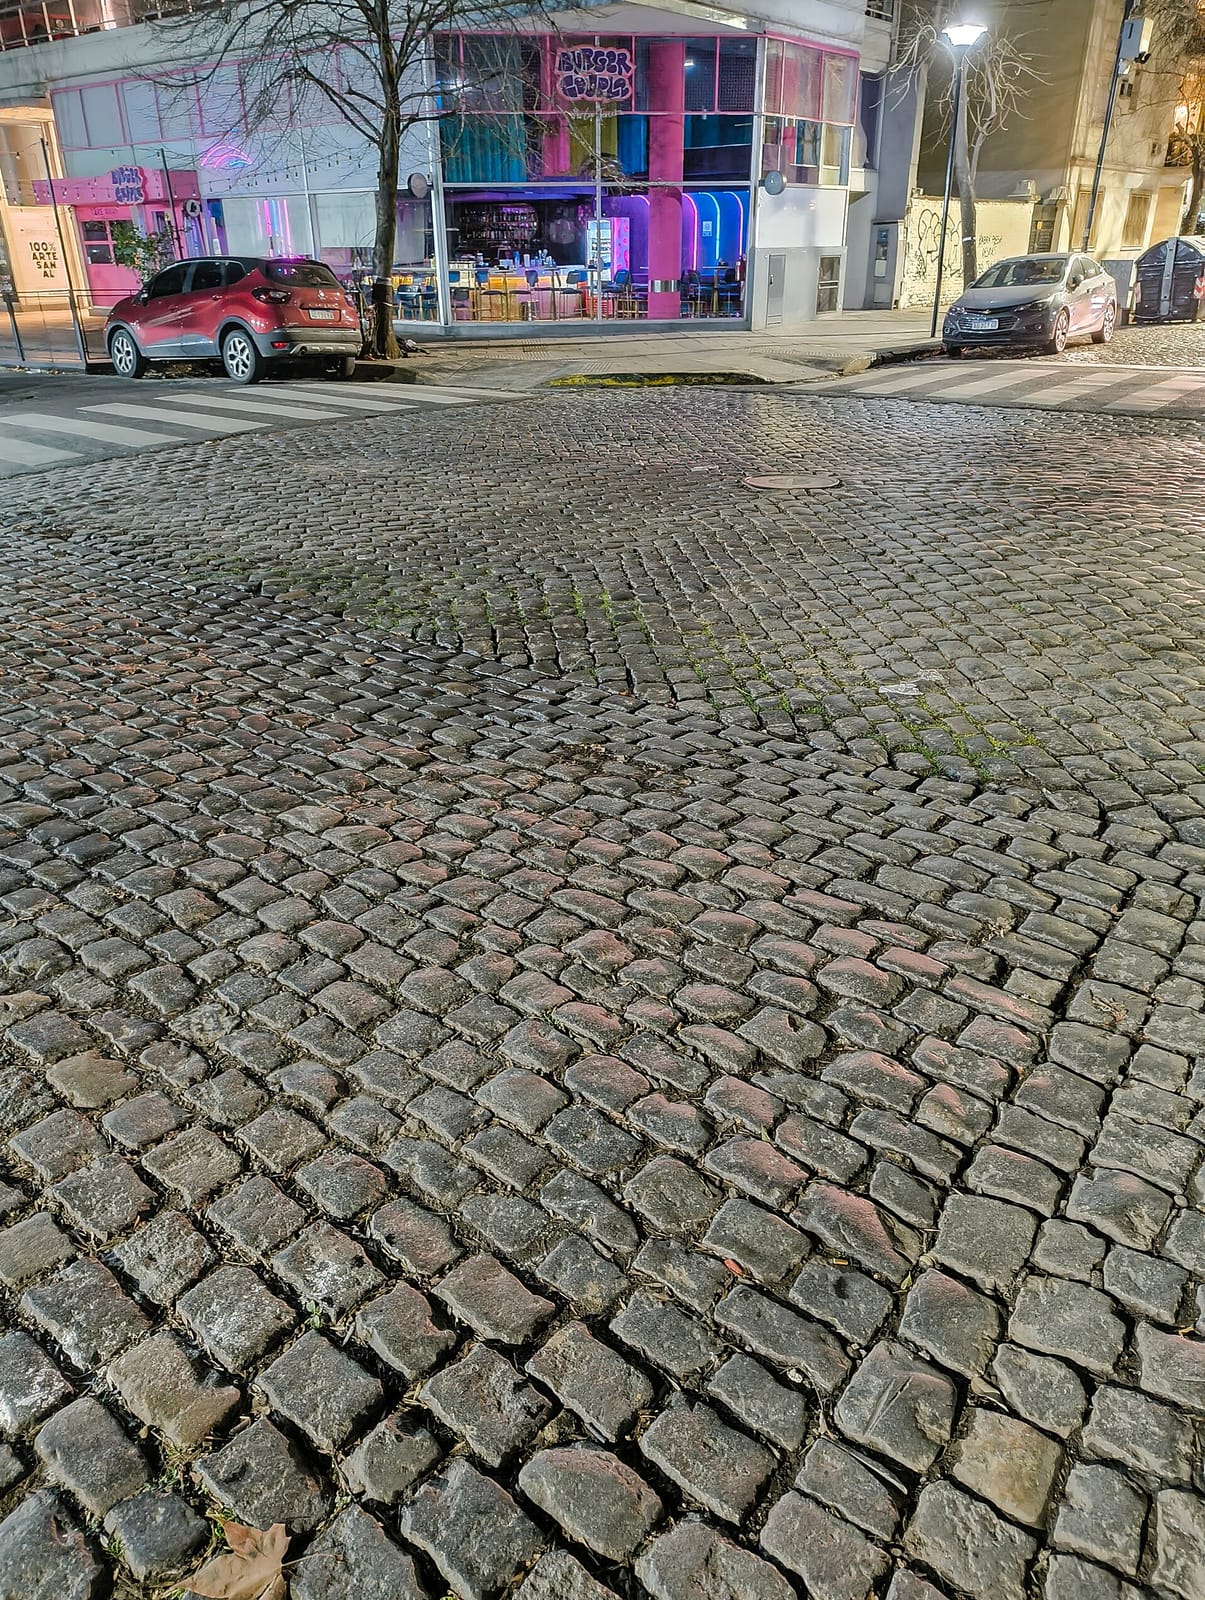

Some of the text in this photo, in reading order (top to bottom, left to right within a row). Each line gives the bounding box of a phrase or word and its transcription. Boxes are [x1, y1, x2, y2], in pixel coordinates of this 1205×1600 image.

[557, 47, 632, 75] BURGER
[559, 75, 631, 98] COUPLE
[29, 242, 56, 251] 100%
[32, 252, 58, 261] ARTE
[36, 261, 57, 269] SAN
[43, 270, 55, 278] AL
